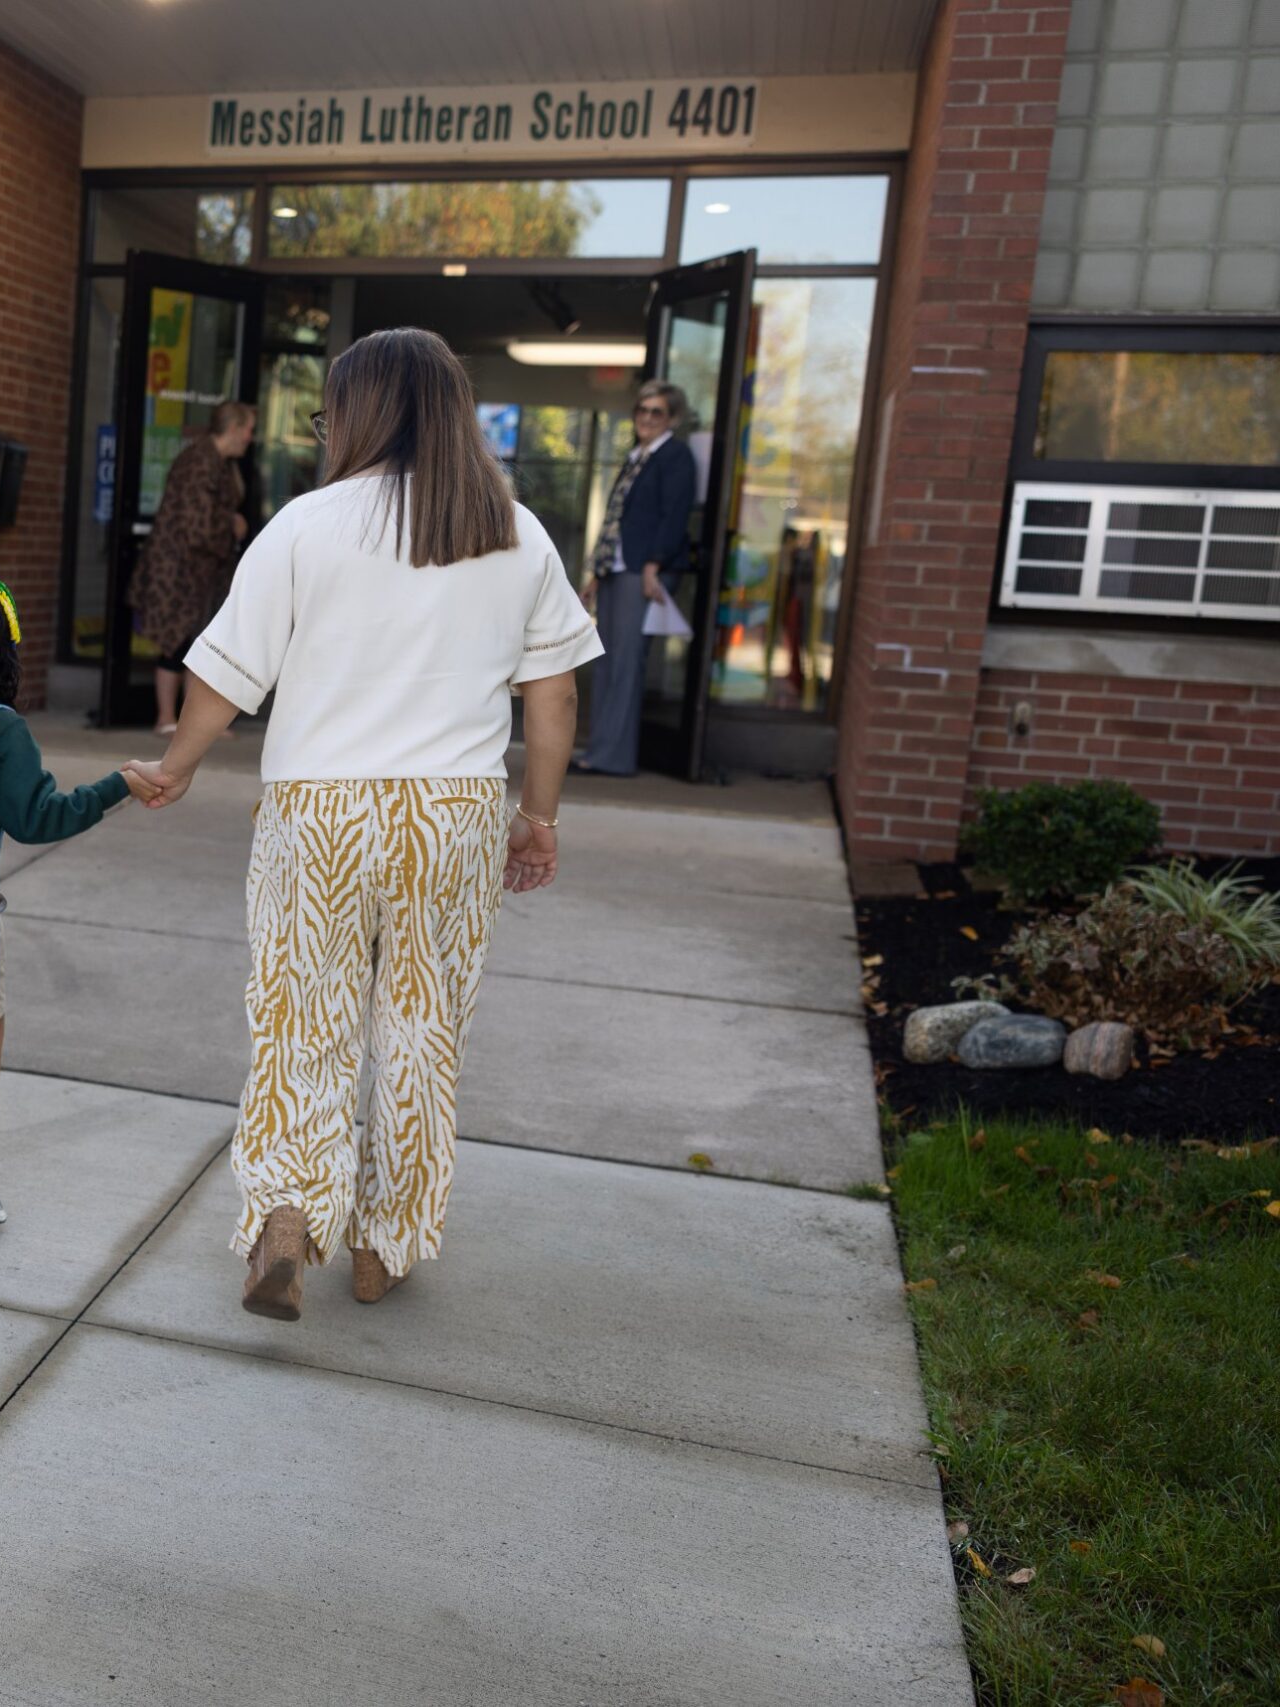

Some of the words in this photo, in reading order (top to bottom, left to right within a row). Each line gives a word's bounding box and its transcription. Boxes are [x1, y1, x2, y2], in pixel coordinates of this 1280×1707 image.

[210, 97, 344, 146] Messiah
[360, 95, 512, 144] Lutheran
[530, 87, 654, 141] School
[668, 84, 756, 138] 4401
